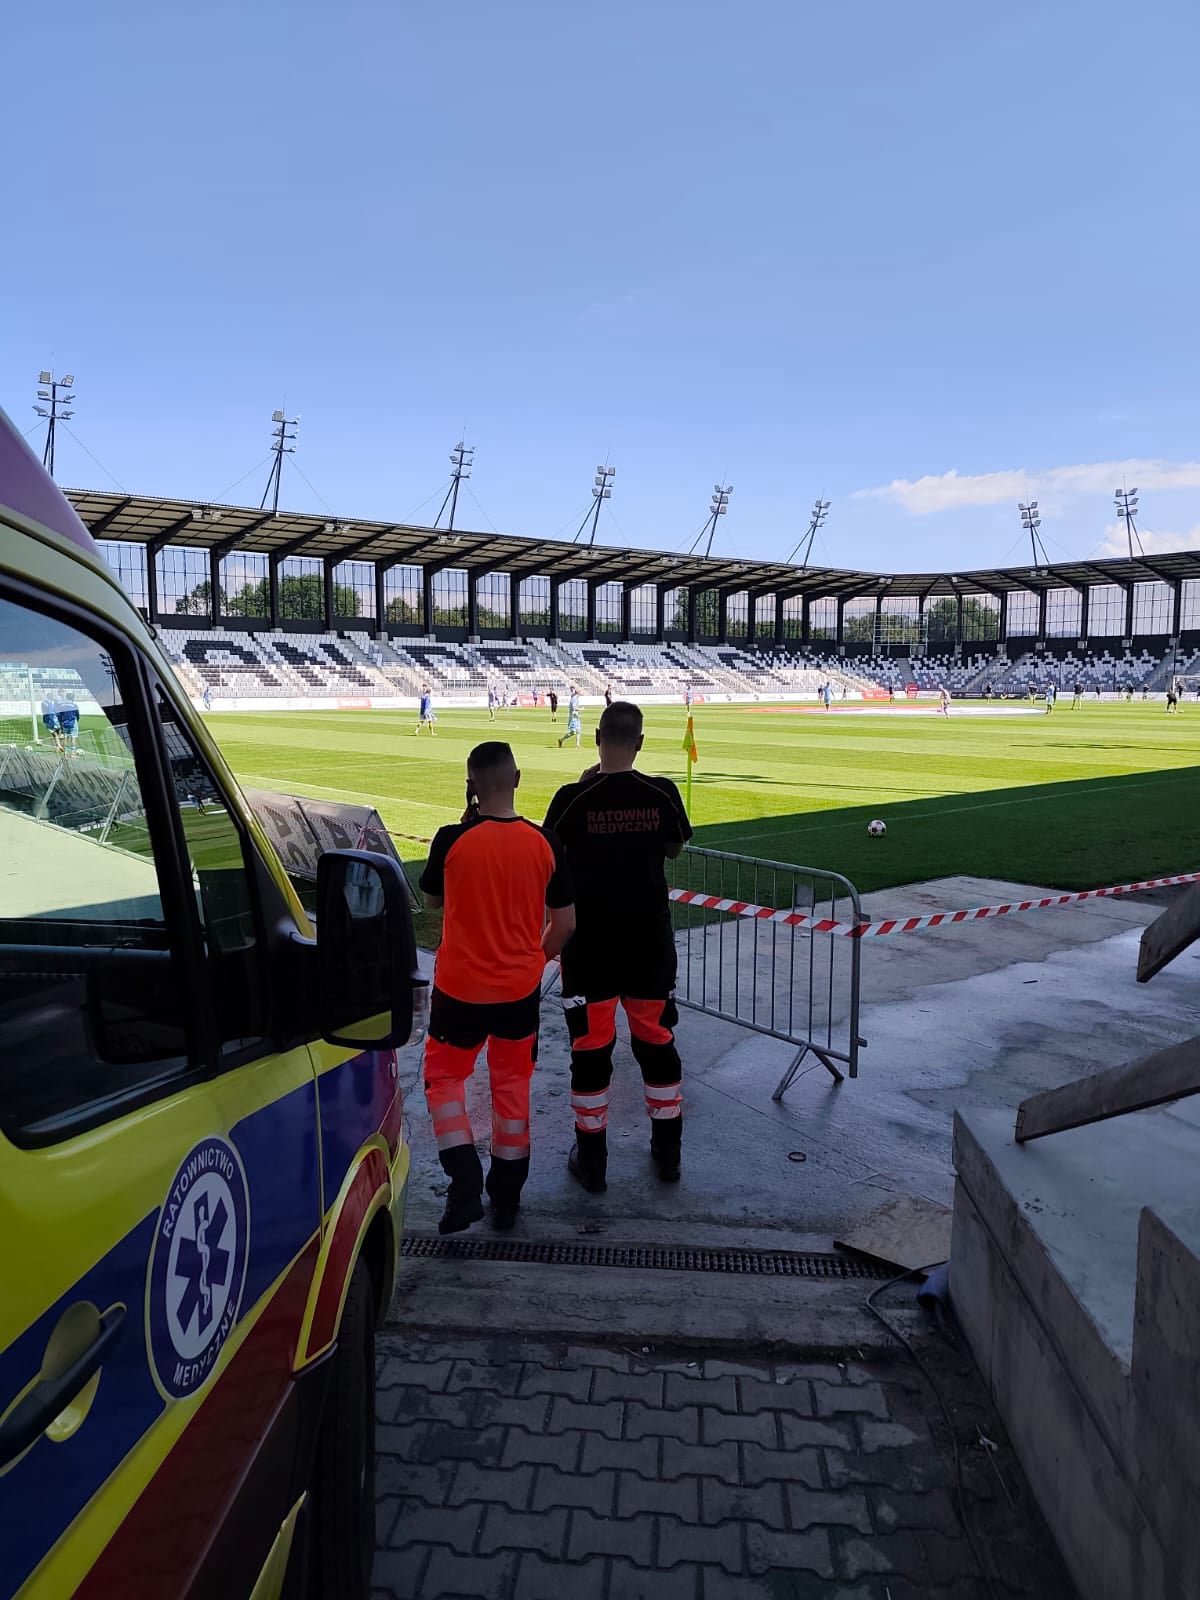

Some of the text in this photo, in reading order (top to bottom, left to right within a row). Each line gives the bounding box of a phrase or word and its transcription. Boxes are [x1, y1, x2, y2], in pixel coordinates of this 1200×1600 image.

[587, 808, 660, 823] RATOWNIK
[587, 821, 660, 834] MEDYCZNY
[162, 1148, 234, 1238] RATOWNICTWO
[173, 1301, 235, 1387] MEDYCZNE
